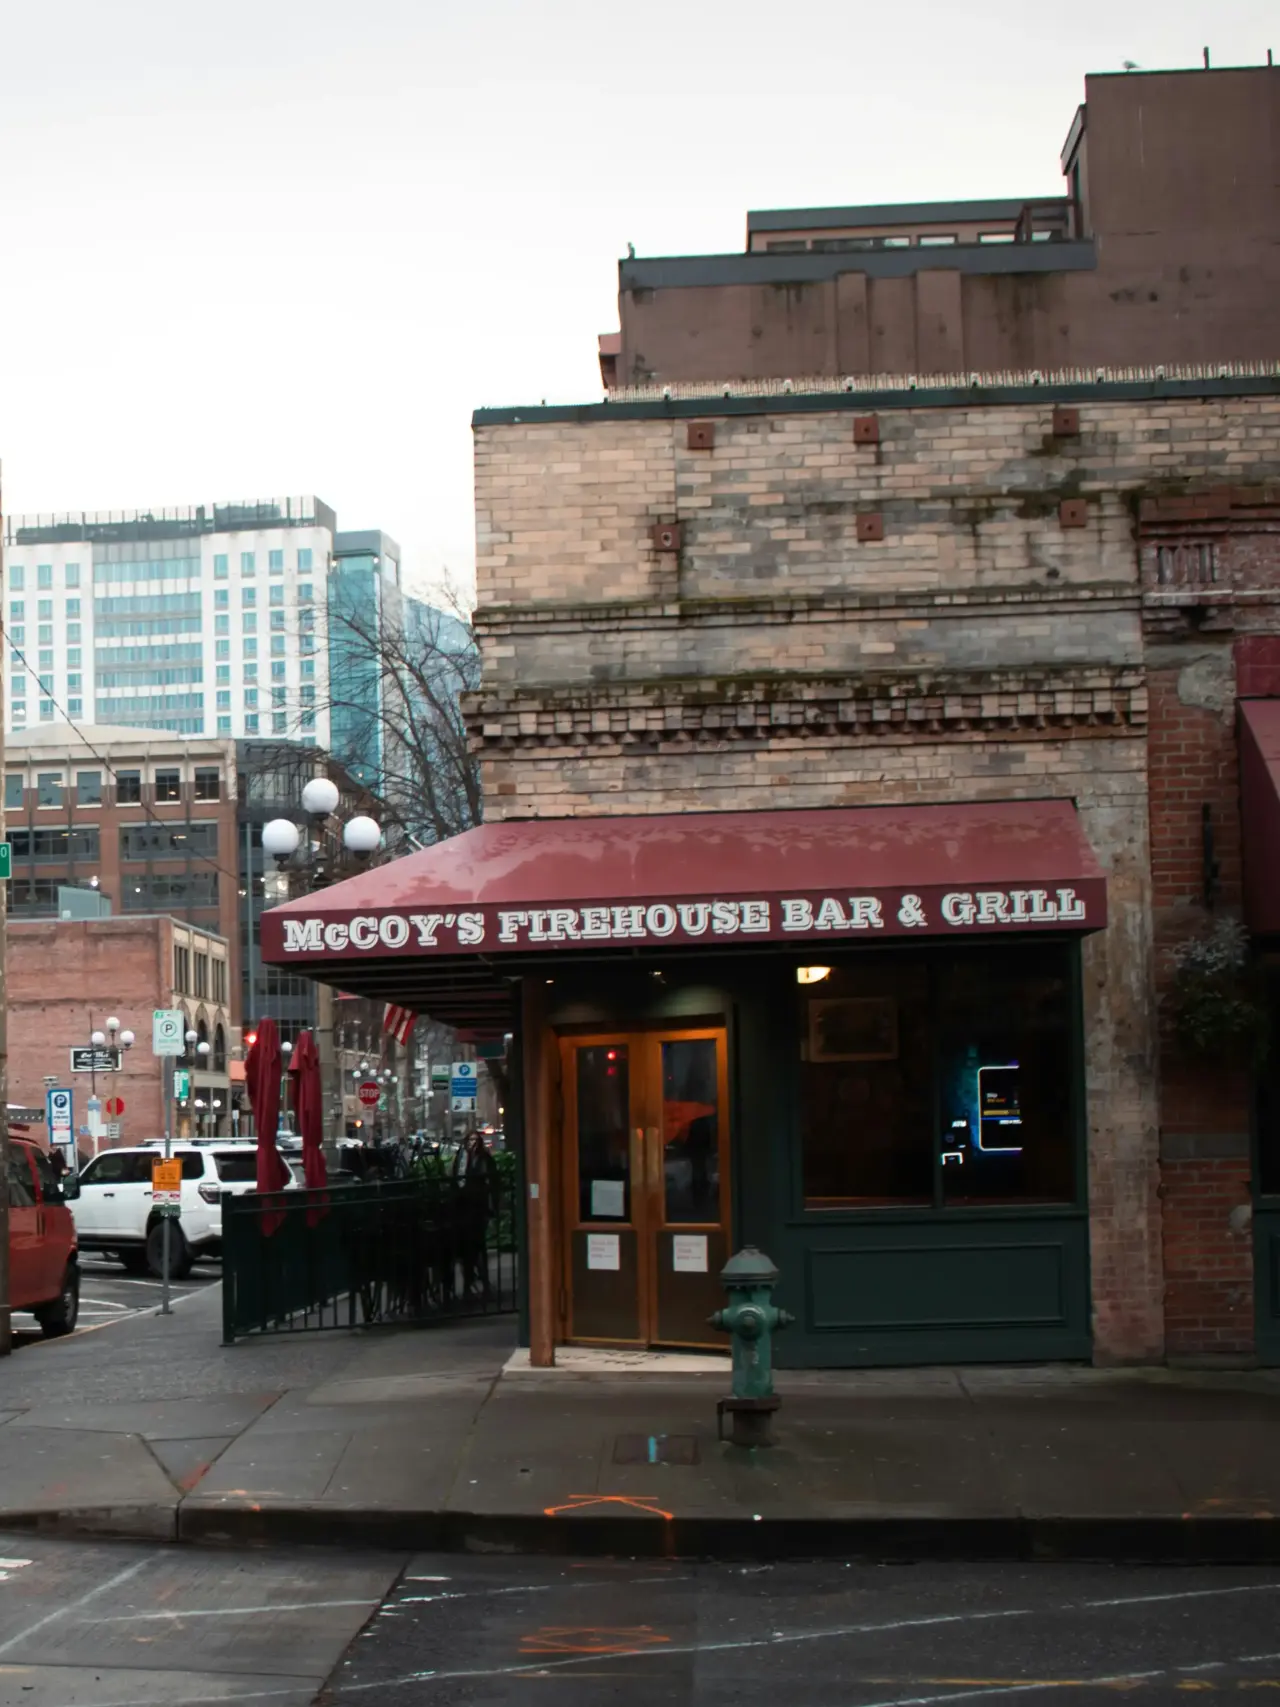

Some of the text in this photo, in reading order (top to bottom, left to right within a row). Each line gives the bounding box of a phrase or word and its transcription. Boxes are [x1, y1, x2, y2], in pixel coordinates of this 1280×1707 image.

[282, 888, 1086, 951] McCOY'S FIREHOUSE BAR & GRILL
[359, 1088, 379, 1098] STOP
